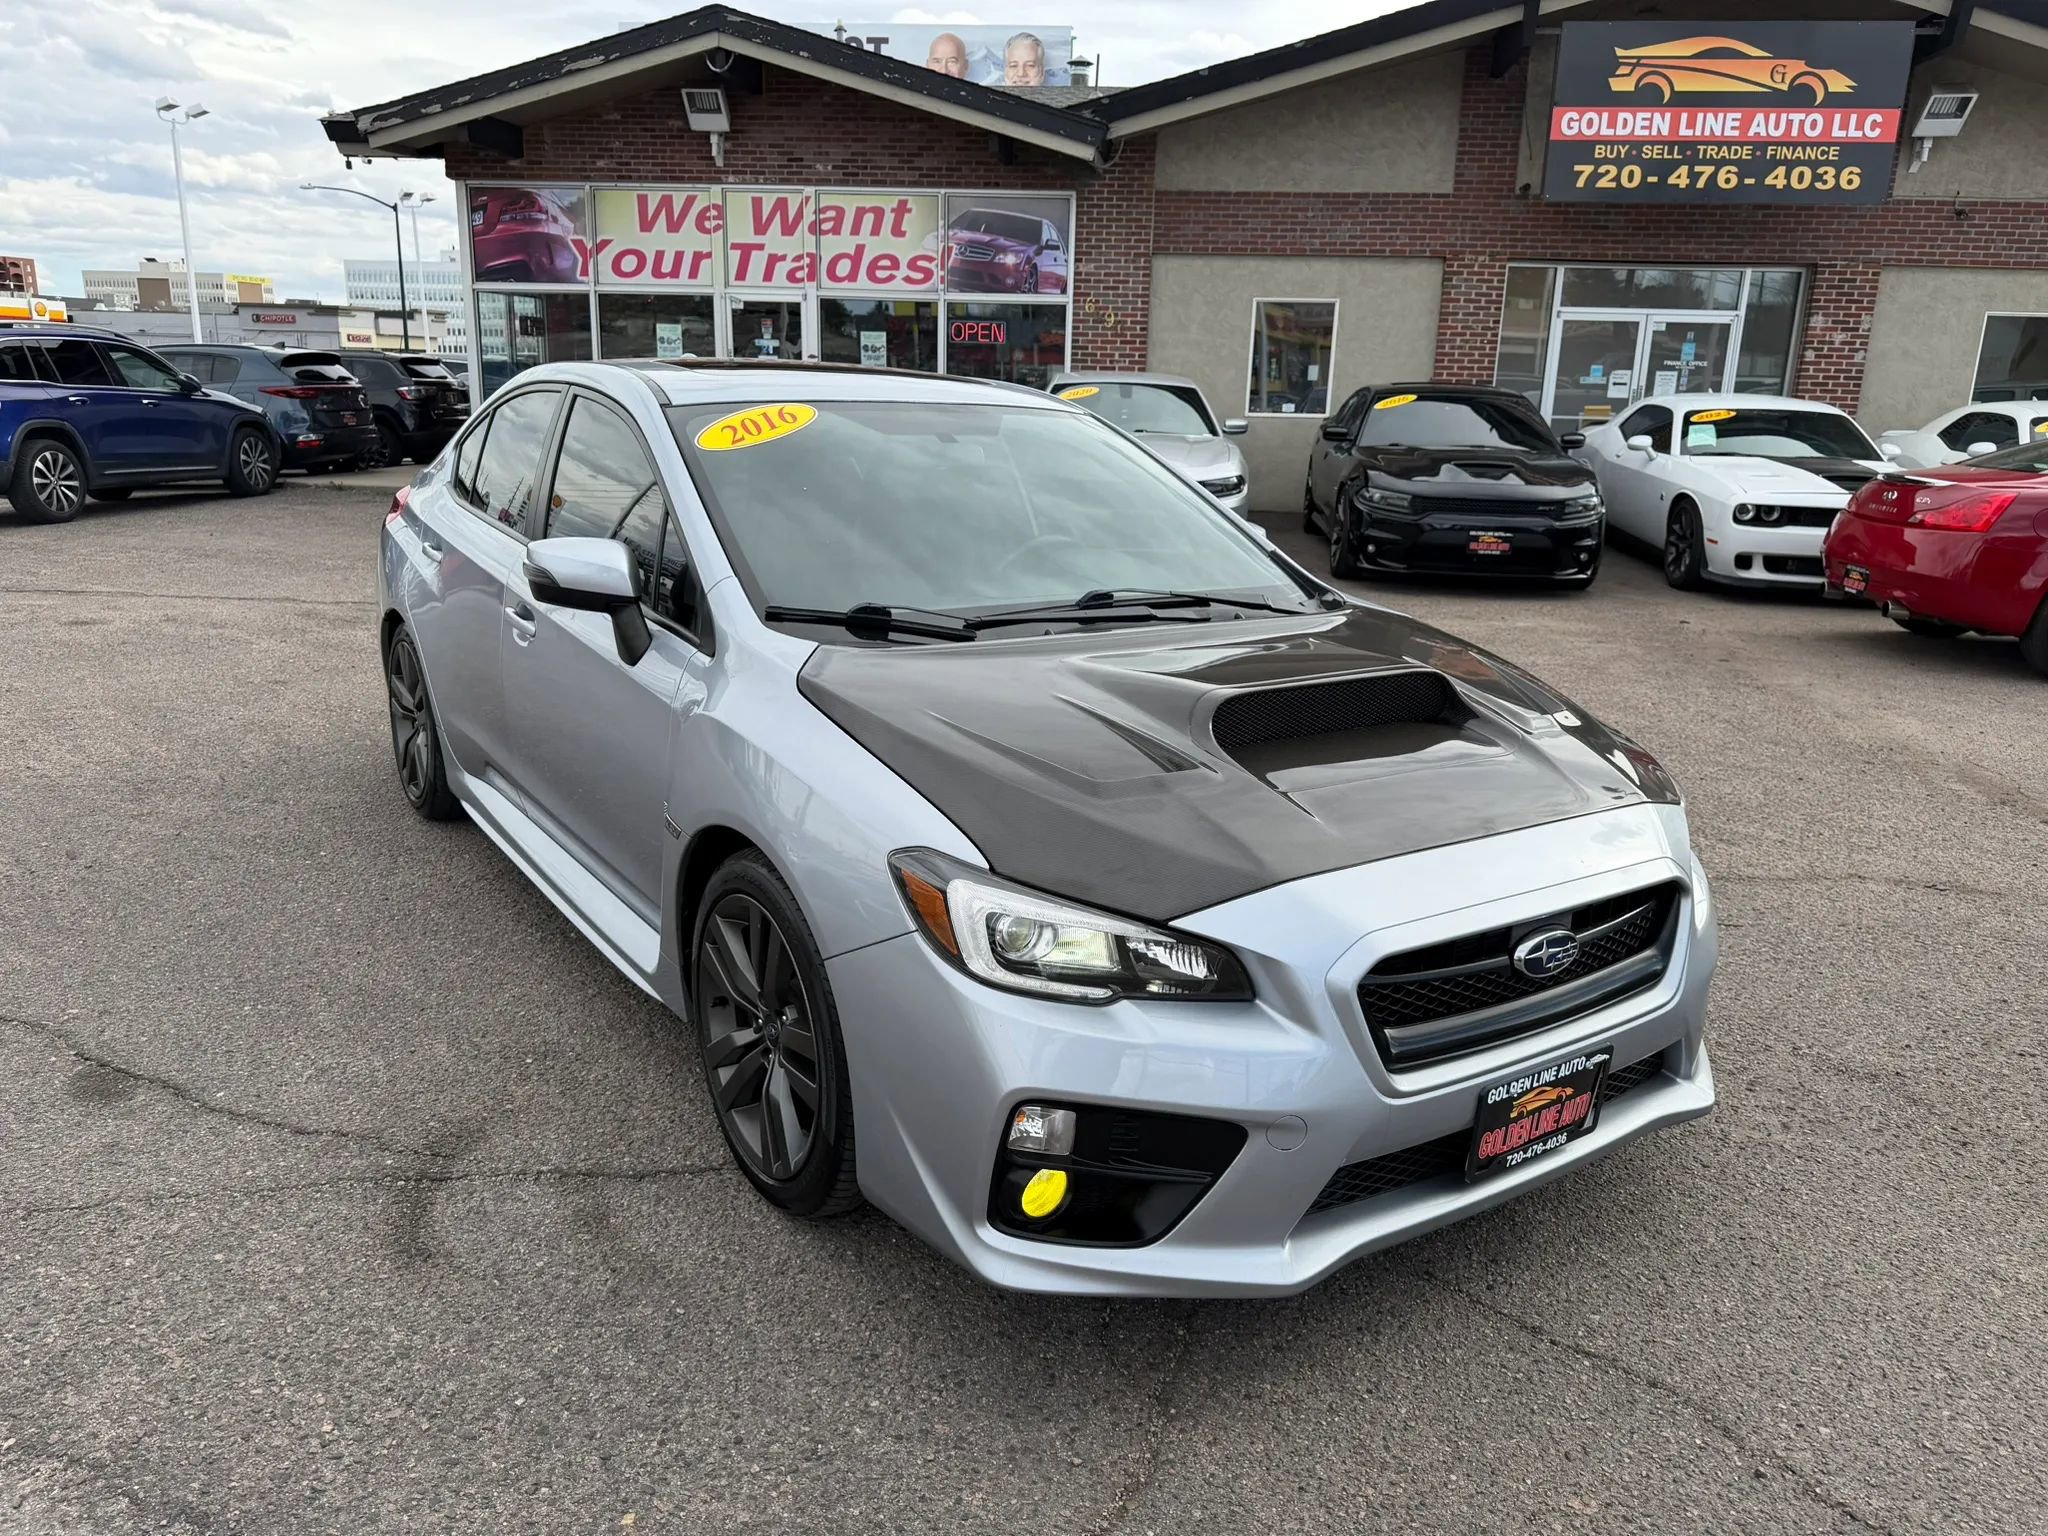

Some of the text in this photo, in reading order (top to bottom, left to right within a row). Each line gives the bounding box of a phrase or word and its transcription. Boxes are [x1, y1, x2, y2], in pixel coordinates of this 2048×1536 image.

[1560, 111, 1884, 138] GOLDEN LINE AUTO LLC
[1594, 144, 1840, 160] BUY SELL TRADE FINANCE
[636, 193, 912, 239] We Want
[569, 238, 955, 286] Your Trades!
[951, 322, 1004, 343] OPEN
[721, 406, 798, 446] 2016
[1487, 1056, 1587, 1104] GOLDEN LINE AUTO
[1478, 1091, 1592, 1160] GOLDEN LINE AUTO
[1505, 1132, 1568, 1168] 720-476-4036
